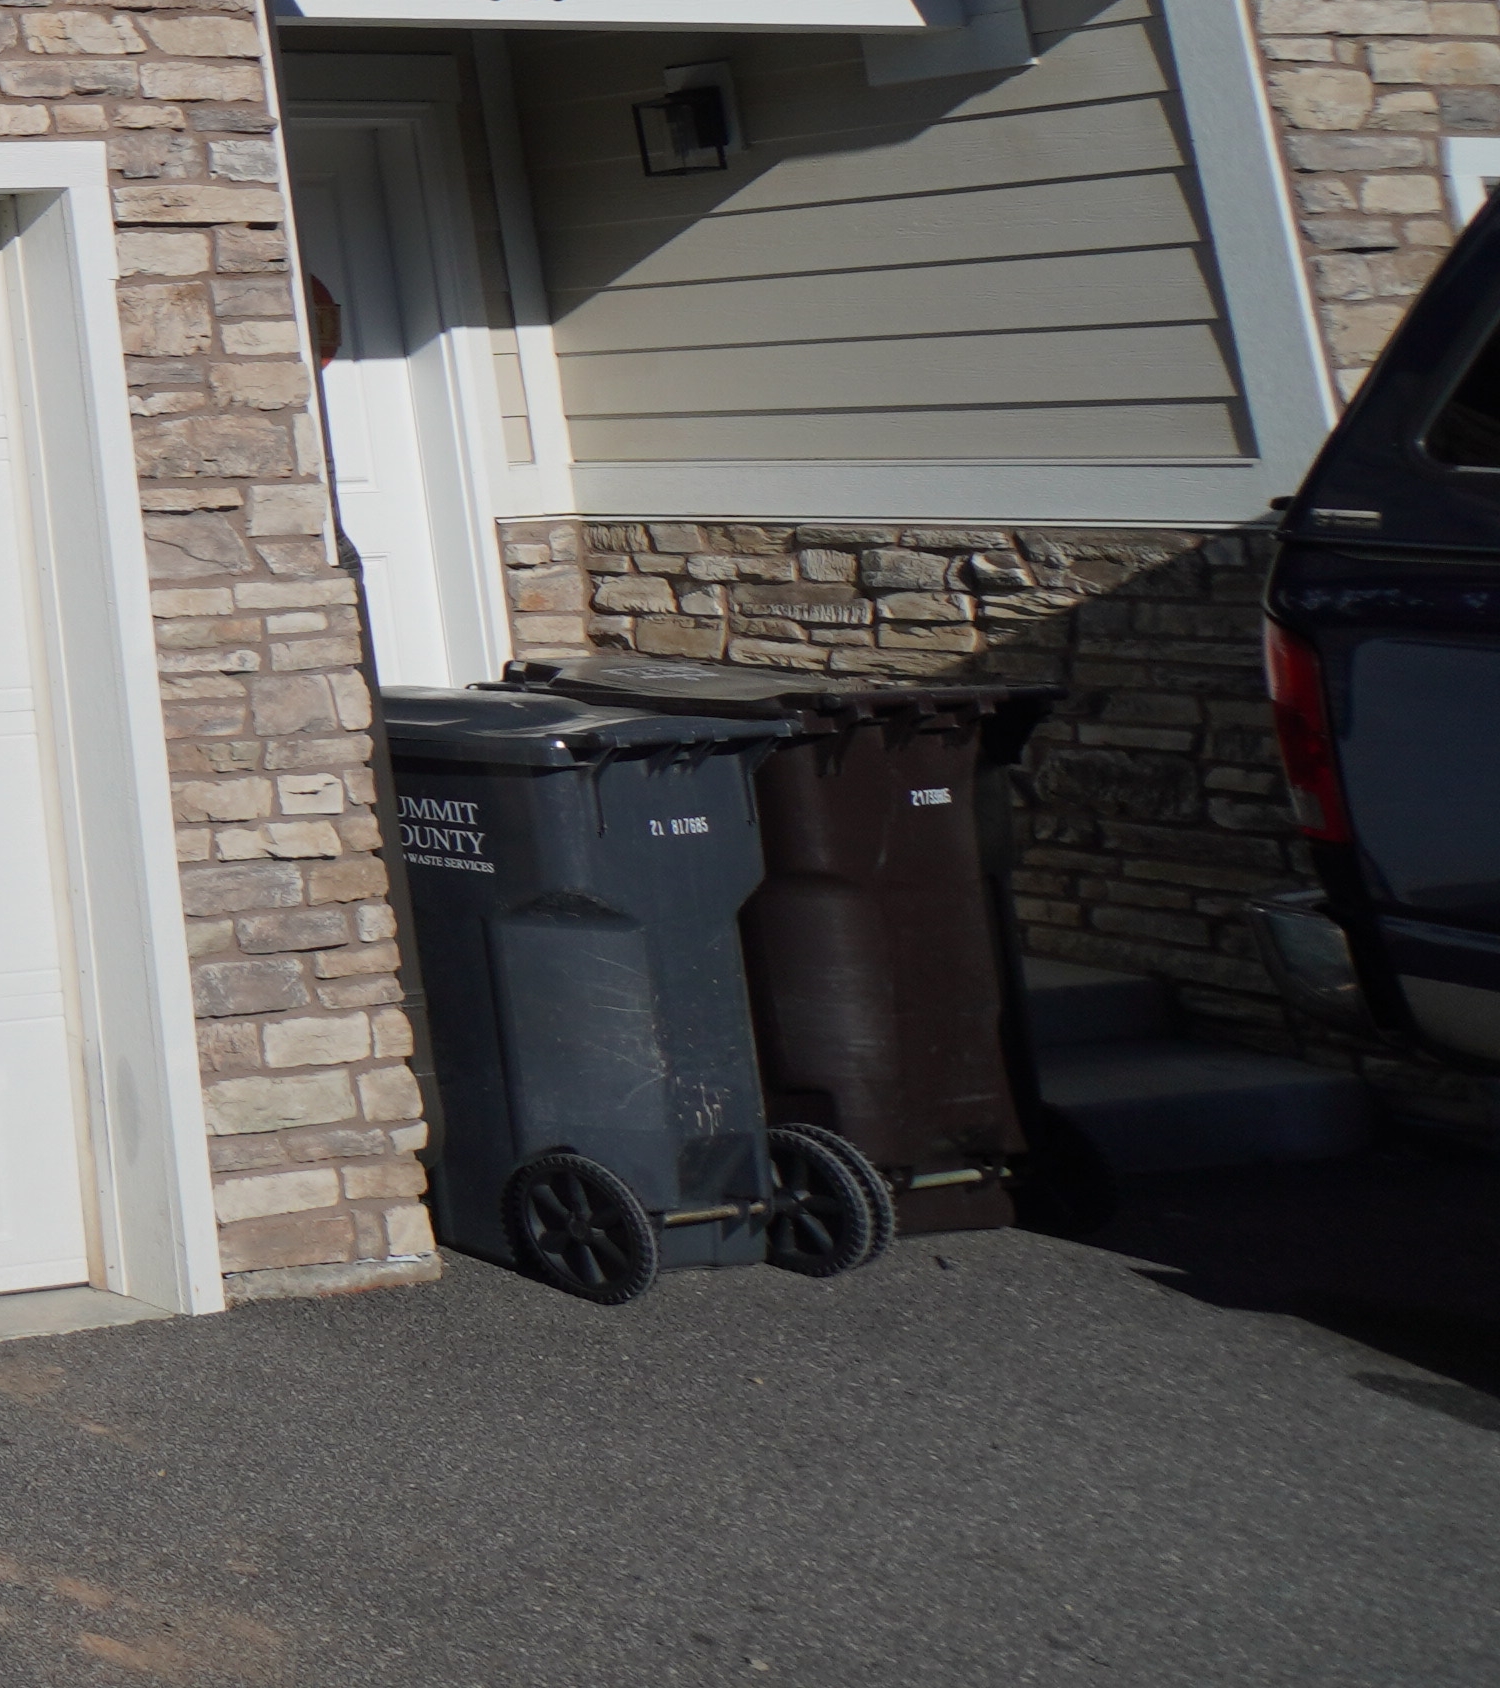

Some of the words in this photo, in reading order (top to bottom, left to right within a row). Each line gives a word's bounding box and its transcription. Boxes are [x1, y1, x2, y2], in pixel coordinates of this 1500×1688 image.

[397, 795, 480, 825] UMMIT
[398, 823, 486, 855] OUNTY
[408, 852, 443, 866] WASTE
[443, 857, 495, 874] SERVICES
